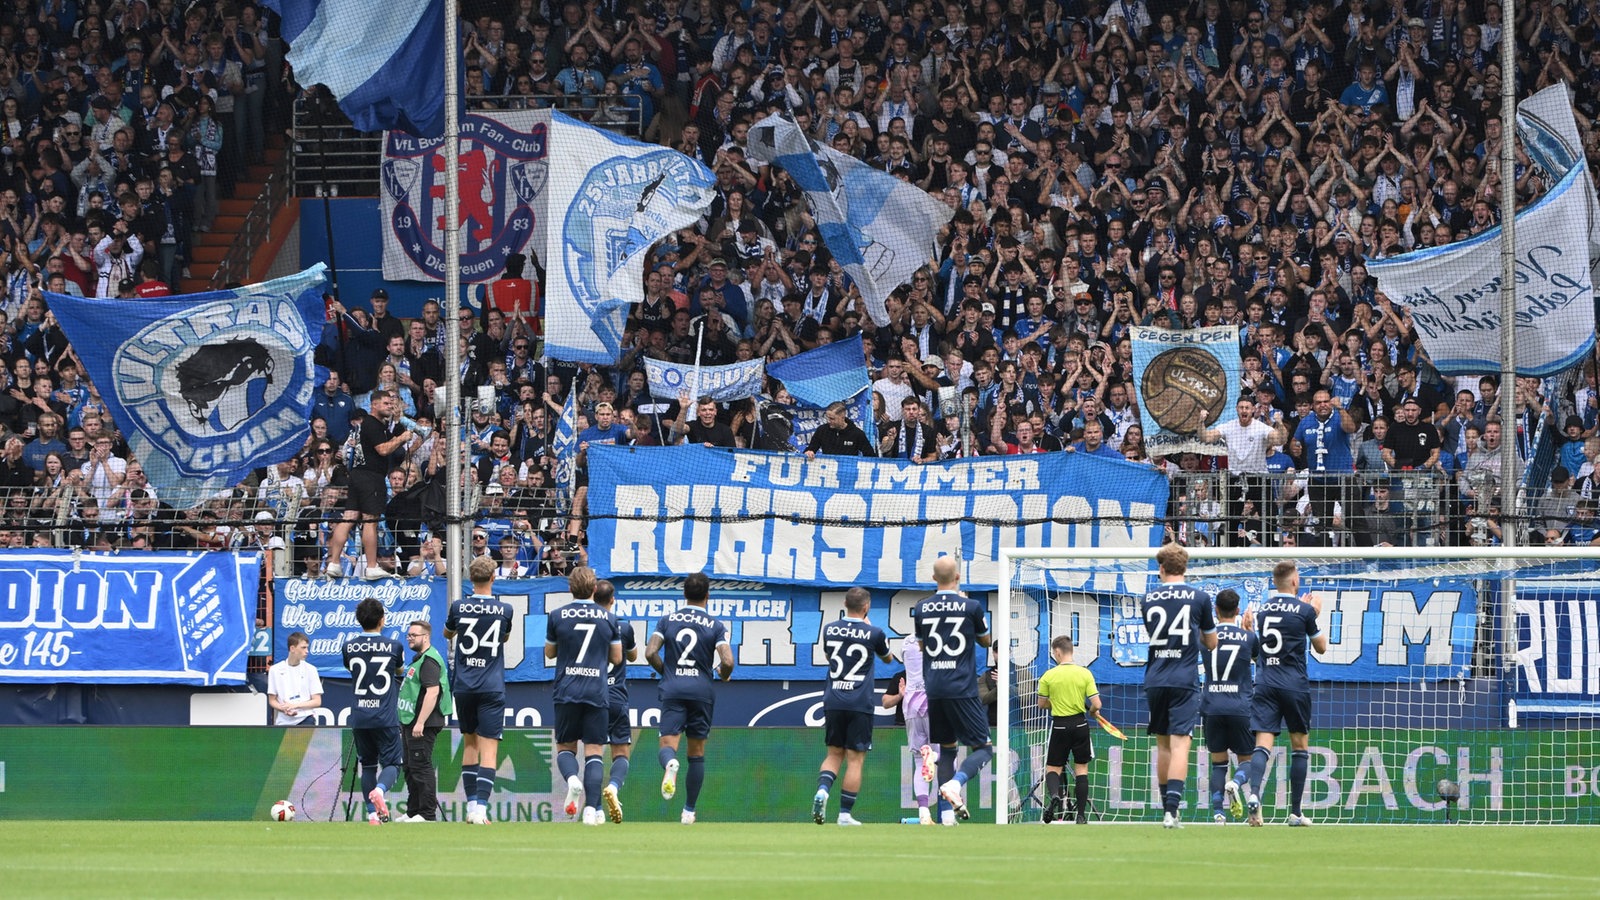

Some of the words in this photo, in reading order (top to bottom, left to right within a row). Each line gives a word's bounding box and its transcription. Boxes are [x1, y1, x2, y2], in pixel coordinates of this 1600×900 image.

[395, 138, 414, 150] VfL
[419, 122, 474, 149] Bocm
[397, 216, 411, 228] 19
[513, 218, 528, 231] 83
[425, 255, 445, 273] Die
[459, 258, 494, 274] reuen
[1138, 331, 1194, 343] GEGEN
[1200, 331, 1232, 341] DEN
[1171, 369, 1218, 398] ULTRAS
[134, 400, 307, 471] BOCHUM
[854, 459, 1041, 490] IMMER
[611, 484, 1156, 594] RUHRSTADION
[284, 578, 318, 602] Geh
[319, 579, 375, 600] deinen
[624, 576, 766, 591] unbeuem
[1145, 590, 1195, 602] BOCHUM
[458, 603, 504, 615] BOCHUM
[561, 608, 608, 620] BOCHUM
[610, 599, 786, 618] NVERUFLICH
[921, 601, 966, 613] BOCHUM
[668, 612, 715, 629] BOCHUM
[1146, 604, 1192, 646] 24
[458, 617, 502, 657] 34
[826, 625, 871, 640] BOCHUM
[921, 616, 967, 657] 33
[1217, 631, 1248, 642] CHUM
[1261, 616, 1283, 654] 5
[347, 642, 392, 653] BOCHUM
[573, 623, 597, 664] 7
[675, 628, 698, 667] 2
[466, 657, 487, 668] MEYER
[826, 640, 869, 682] 32
[1211, 644, 1241, 682] 17
[350, 656, 392, 696] 23
[565, 666, 600, 678] RASMUSSEN
[675, 667, 699, 678] KLAIBER
